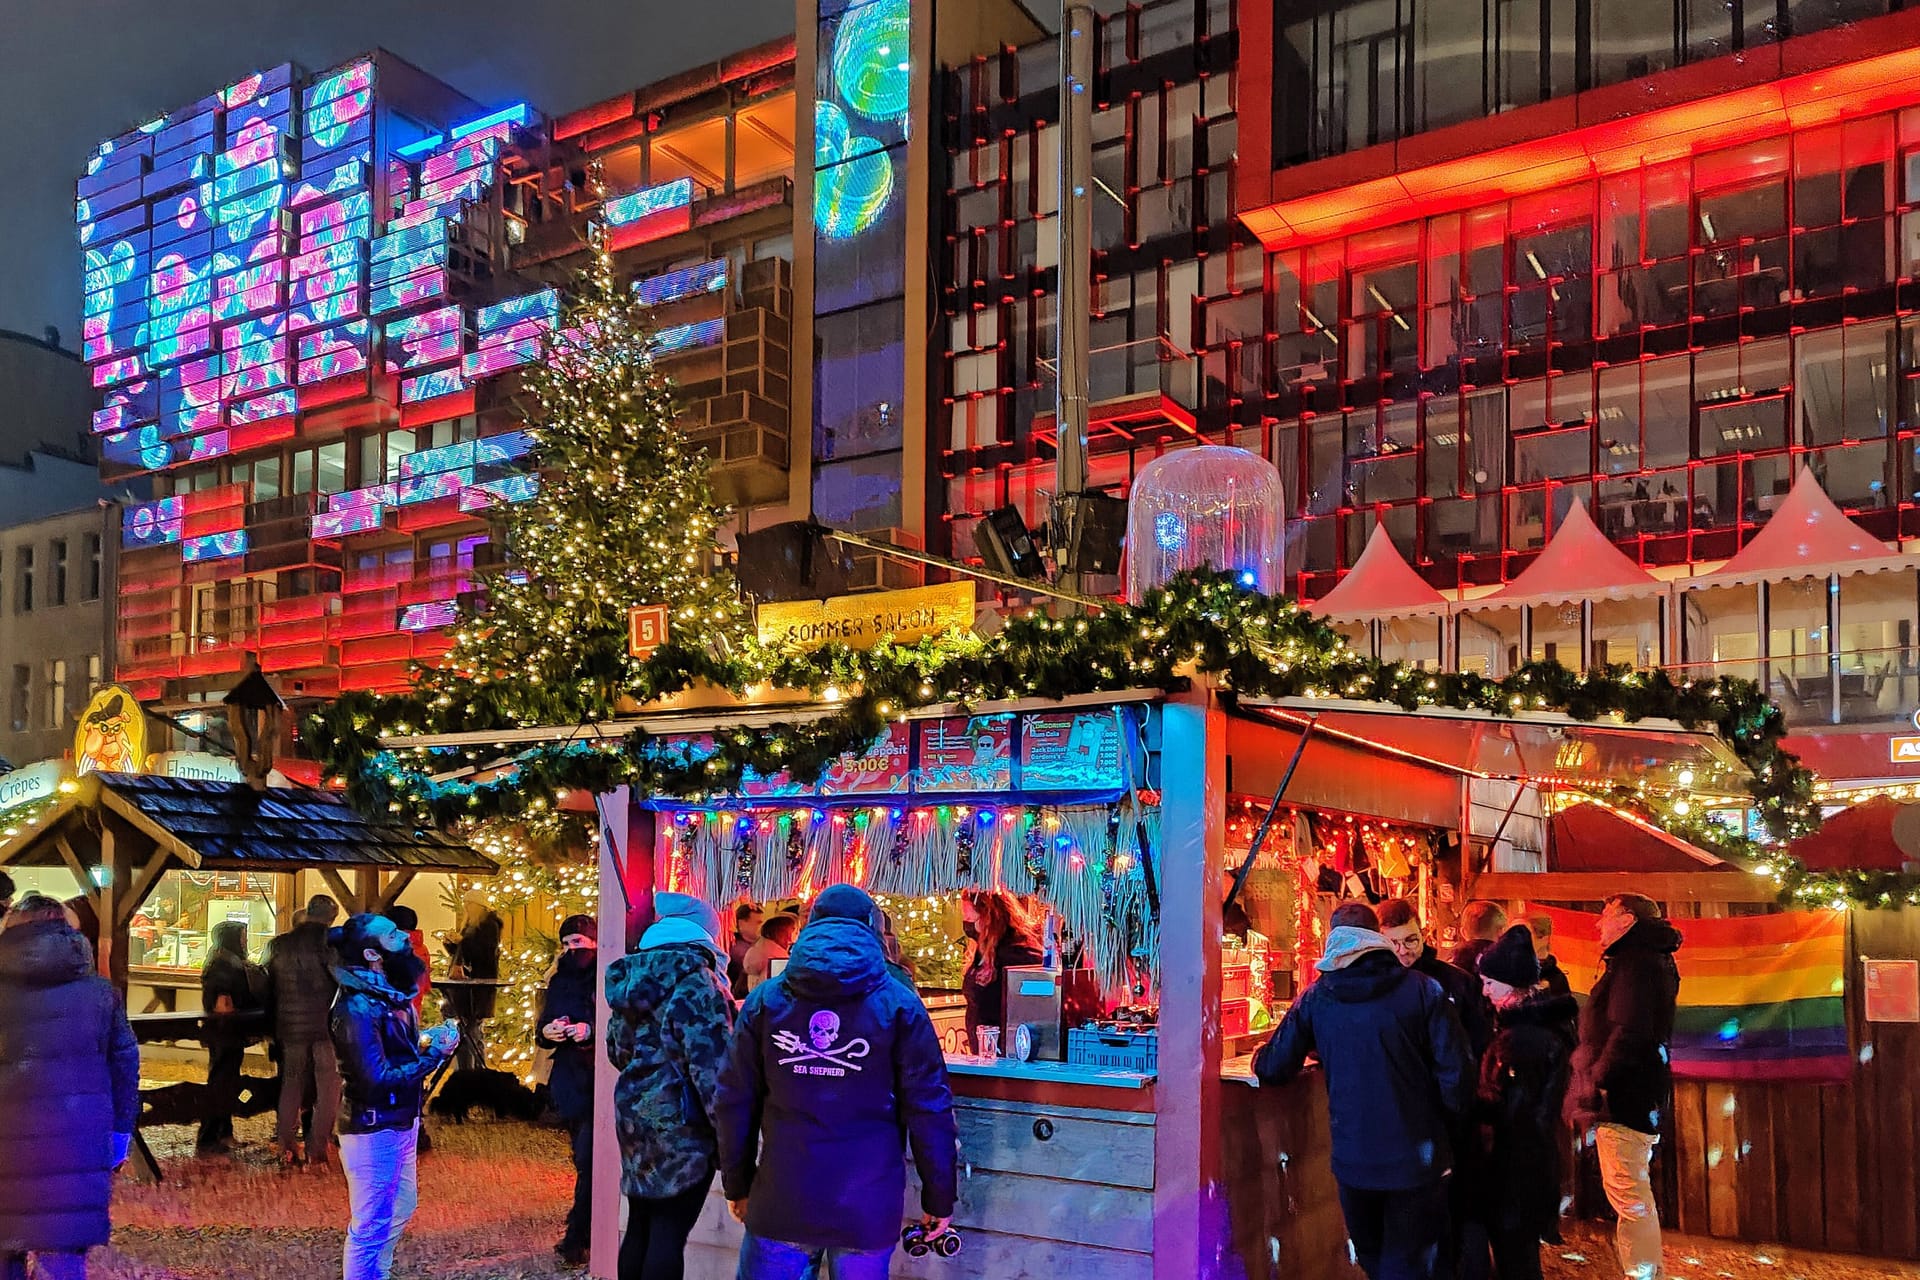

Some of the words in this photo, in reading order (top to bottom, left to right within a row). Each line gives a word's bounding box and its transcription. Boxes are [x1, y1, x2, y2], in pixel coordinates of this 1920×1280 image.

[642, 619, 654, 641] 5
[788, 616, 863, 643] SOMMER
[872, 607, 935, 634] SALON
[845, 757, 889, 772] 3,00€
[0, 777, 40, 803] Crêpes
[793, 1065, 807, 1074] SEA
[809, 1066, 845, 1077] SHEPHERD
